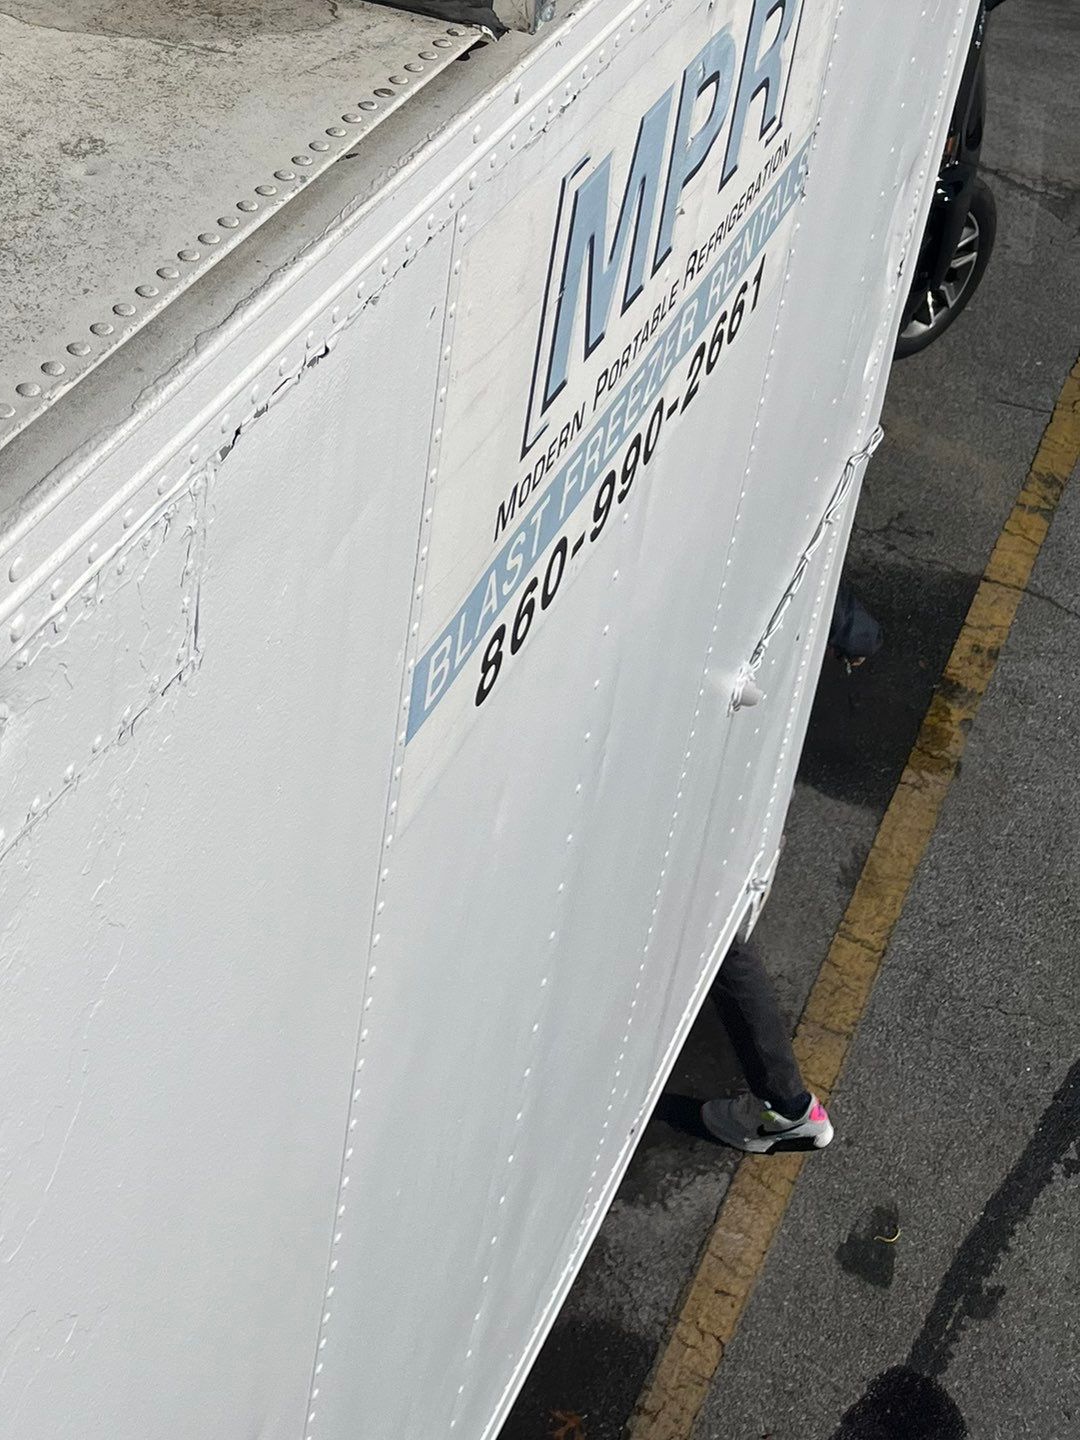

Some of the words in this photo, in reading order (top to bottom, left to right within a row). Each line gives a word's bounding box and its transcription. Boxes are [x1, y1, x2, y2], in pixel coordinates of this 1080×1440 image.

[424, 494, 551, 711] BLAST
[558, 297, 700, 521] FREEZER
[705, 151, 810, 320] RENTALS
[475, 253, 766, 707] 860-990-2661
[493, 401, 587, 543] MODERN
[593, 278, 680, 412] PORTABLE
[683, 132, 793, 290] REFRIGERATION
